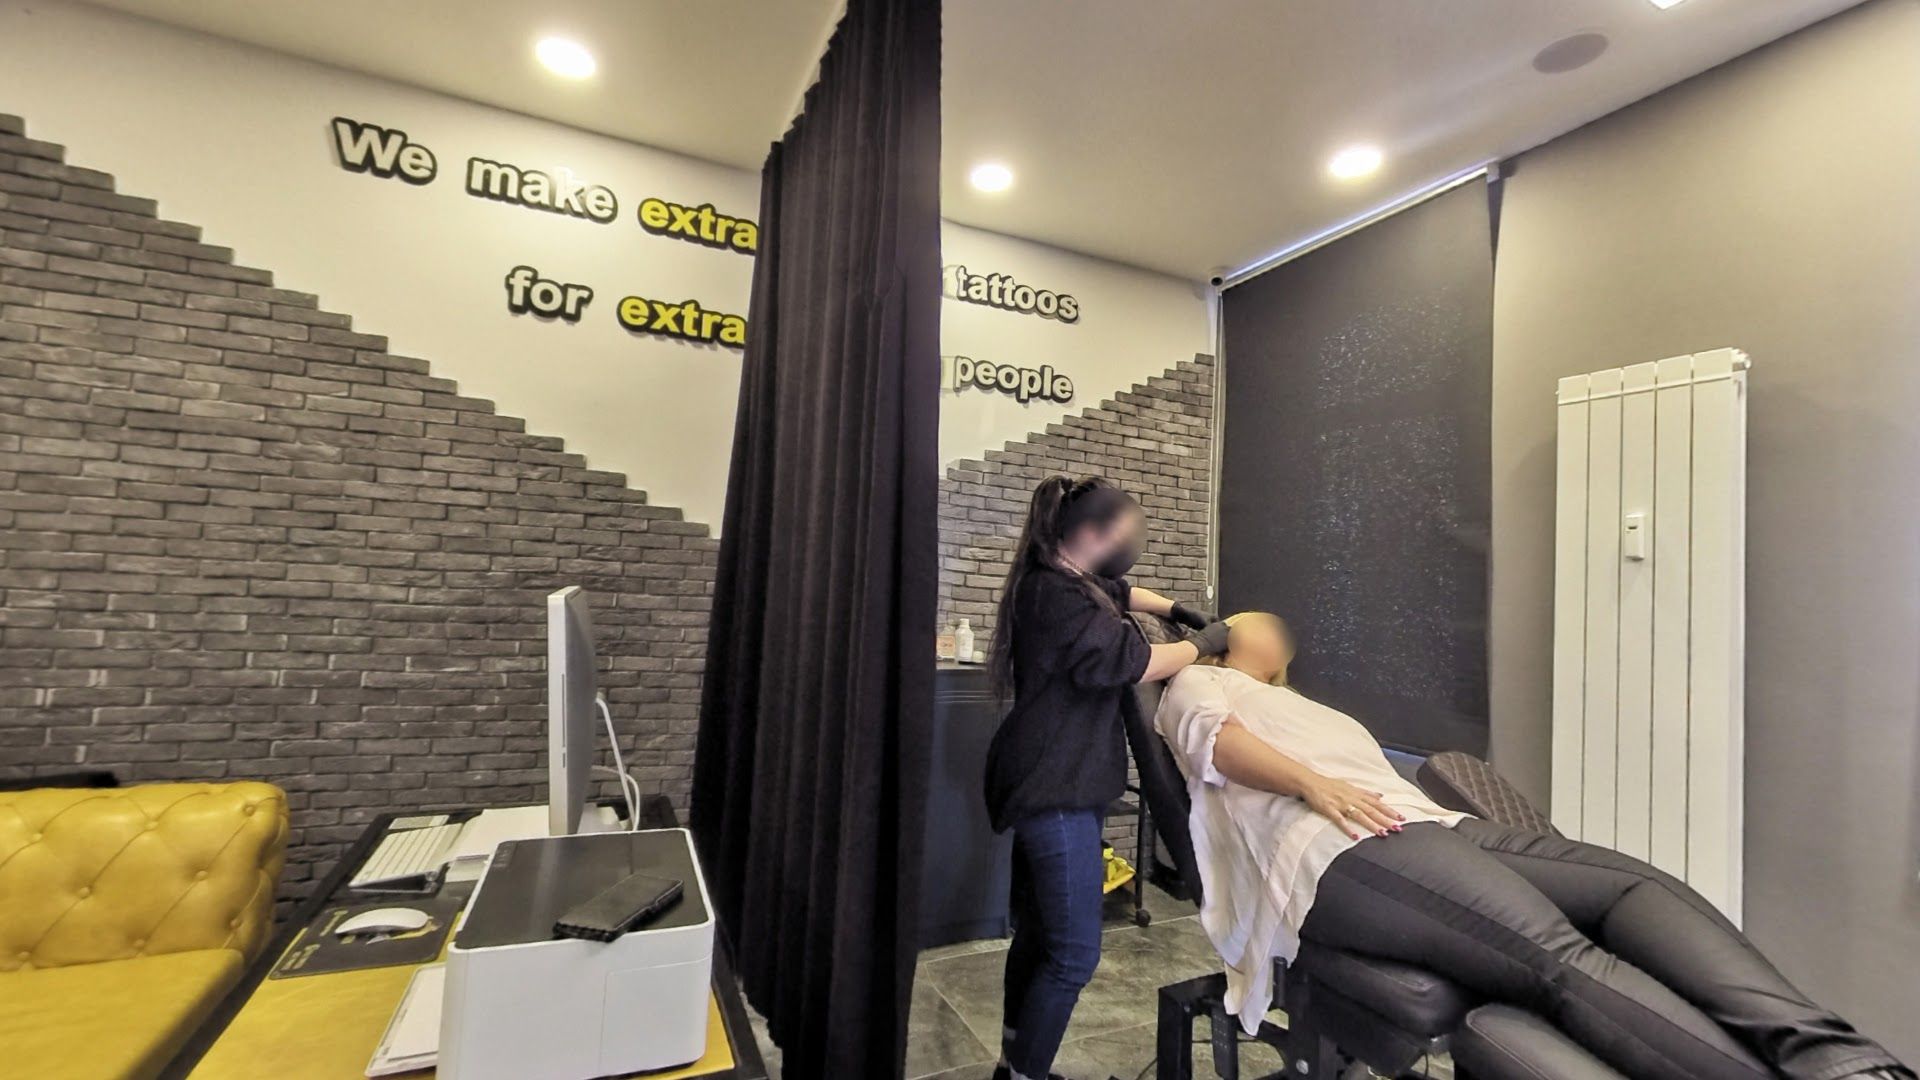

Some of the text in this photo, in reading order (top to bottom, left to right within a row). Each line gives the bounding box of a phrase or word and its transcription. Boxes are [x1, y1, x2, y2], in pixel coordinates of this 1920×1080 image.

[331, 117, 1080, 324] We make extra tattoos
[505, 265, 1074, 403] for extra people
